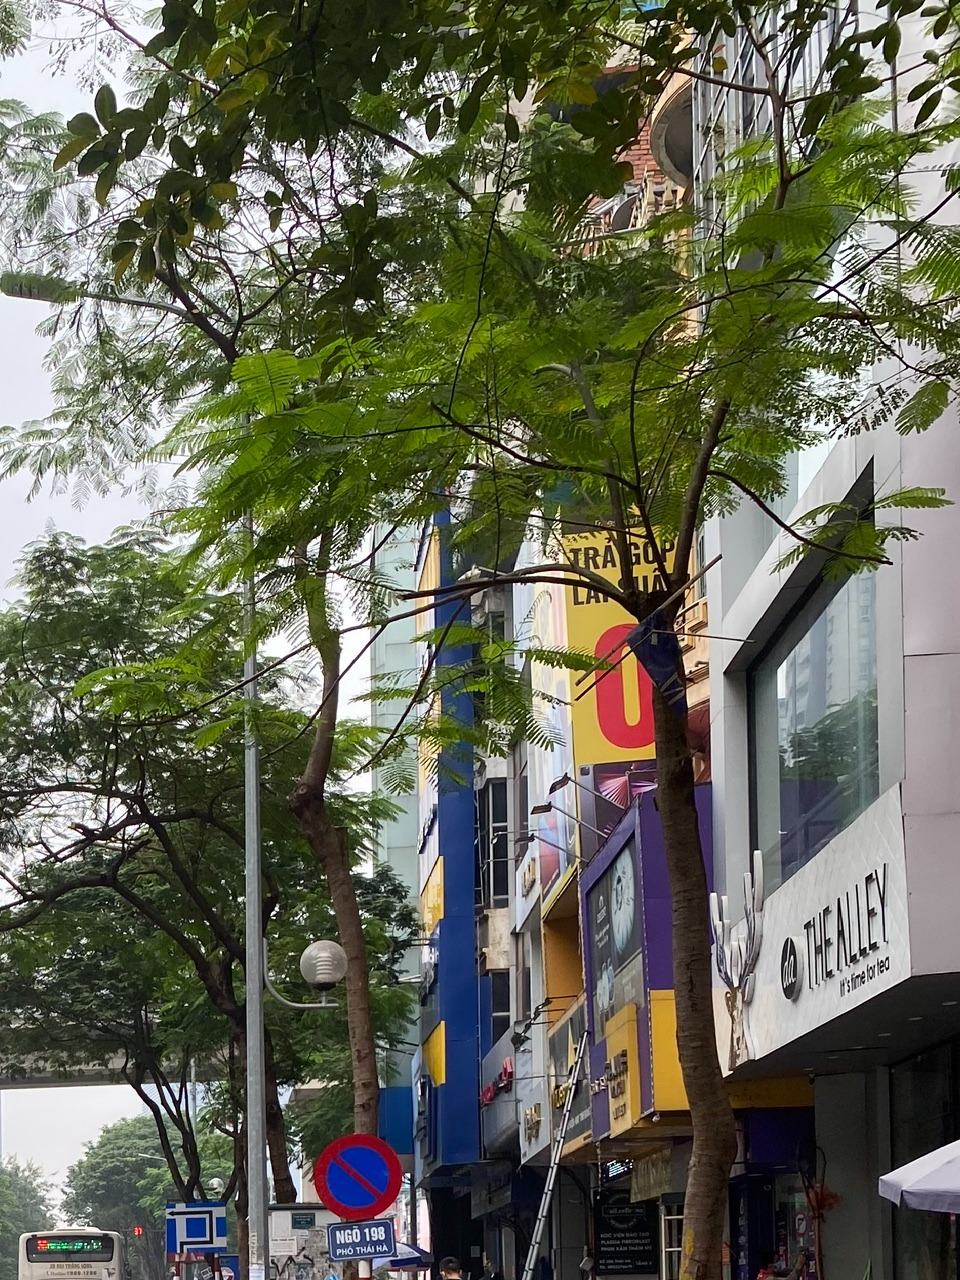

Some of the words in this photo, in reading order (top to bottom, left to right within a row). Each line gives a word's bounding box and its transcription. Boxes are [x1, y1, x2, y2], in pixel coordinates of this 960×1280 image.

[803, 905, 835, 990] THE
[837, 862, 890, 972] ALLEY
[877, 955, 890, 976] tea
[335, 1226, 361, 1244] NGÕ
[363, 1226, 386, 1242] 198
[356, 1243, 375, 1254] THÁI
[376, 1242, 389, 1253] HÀ
